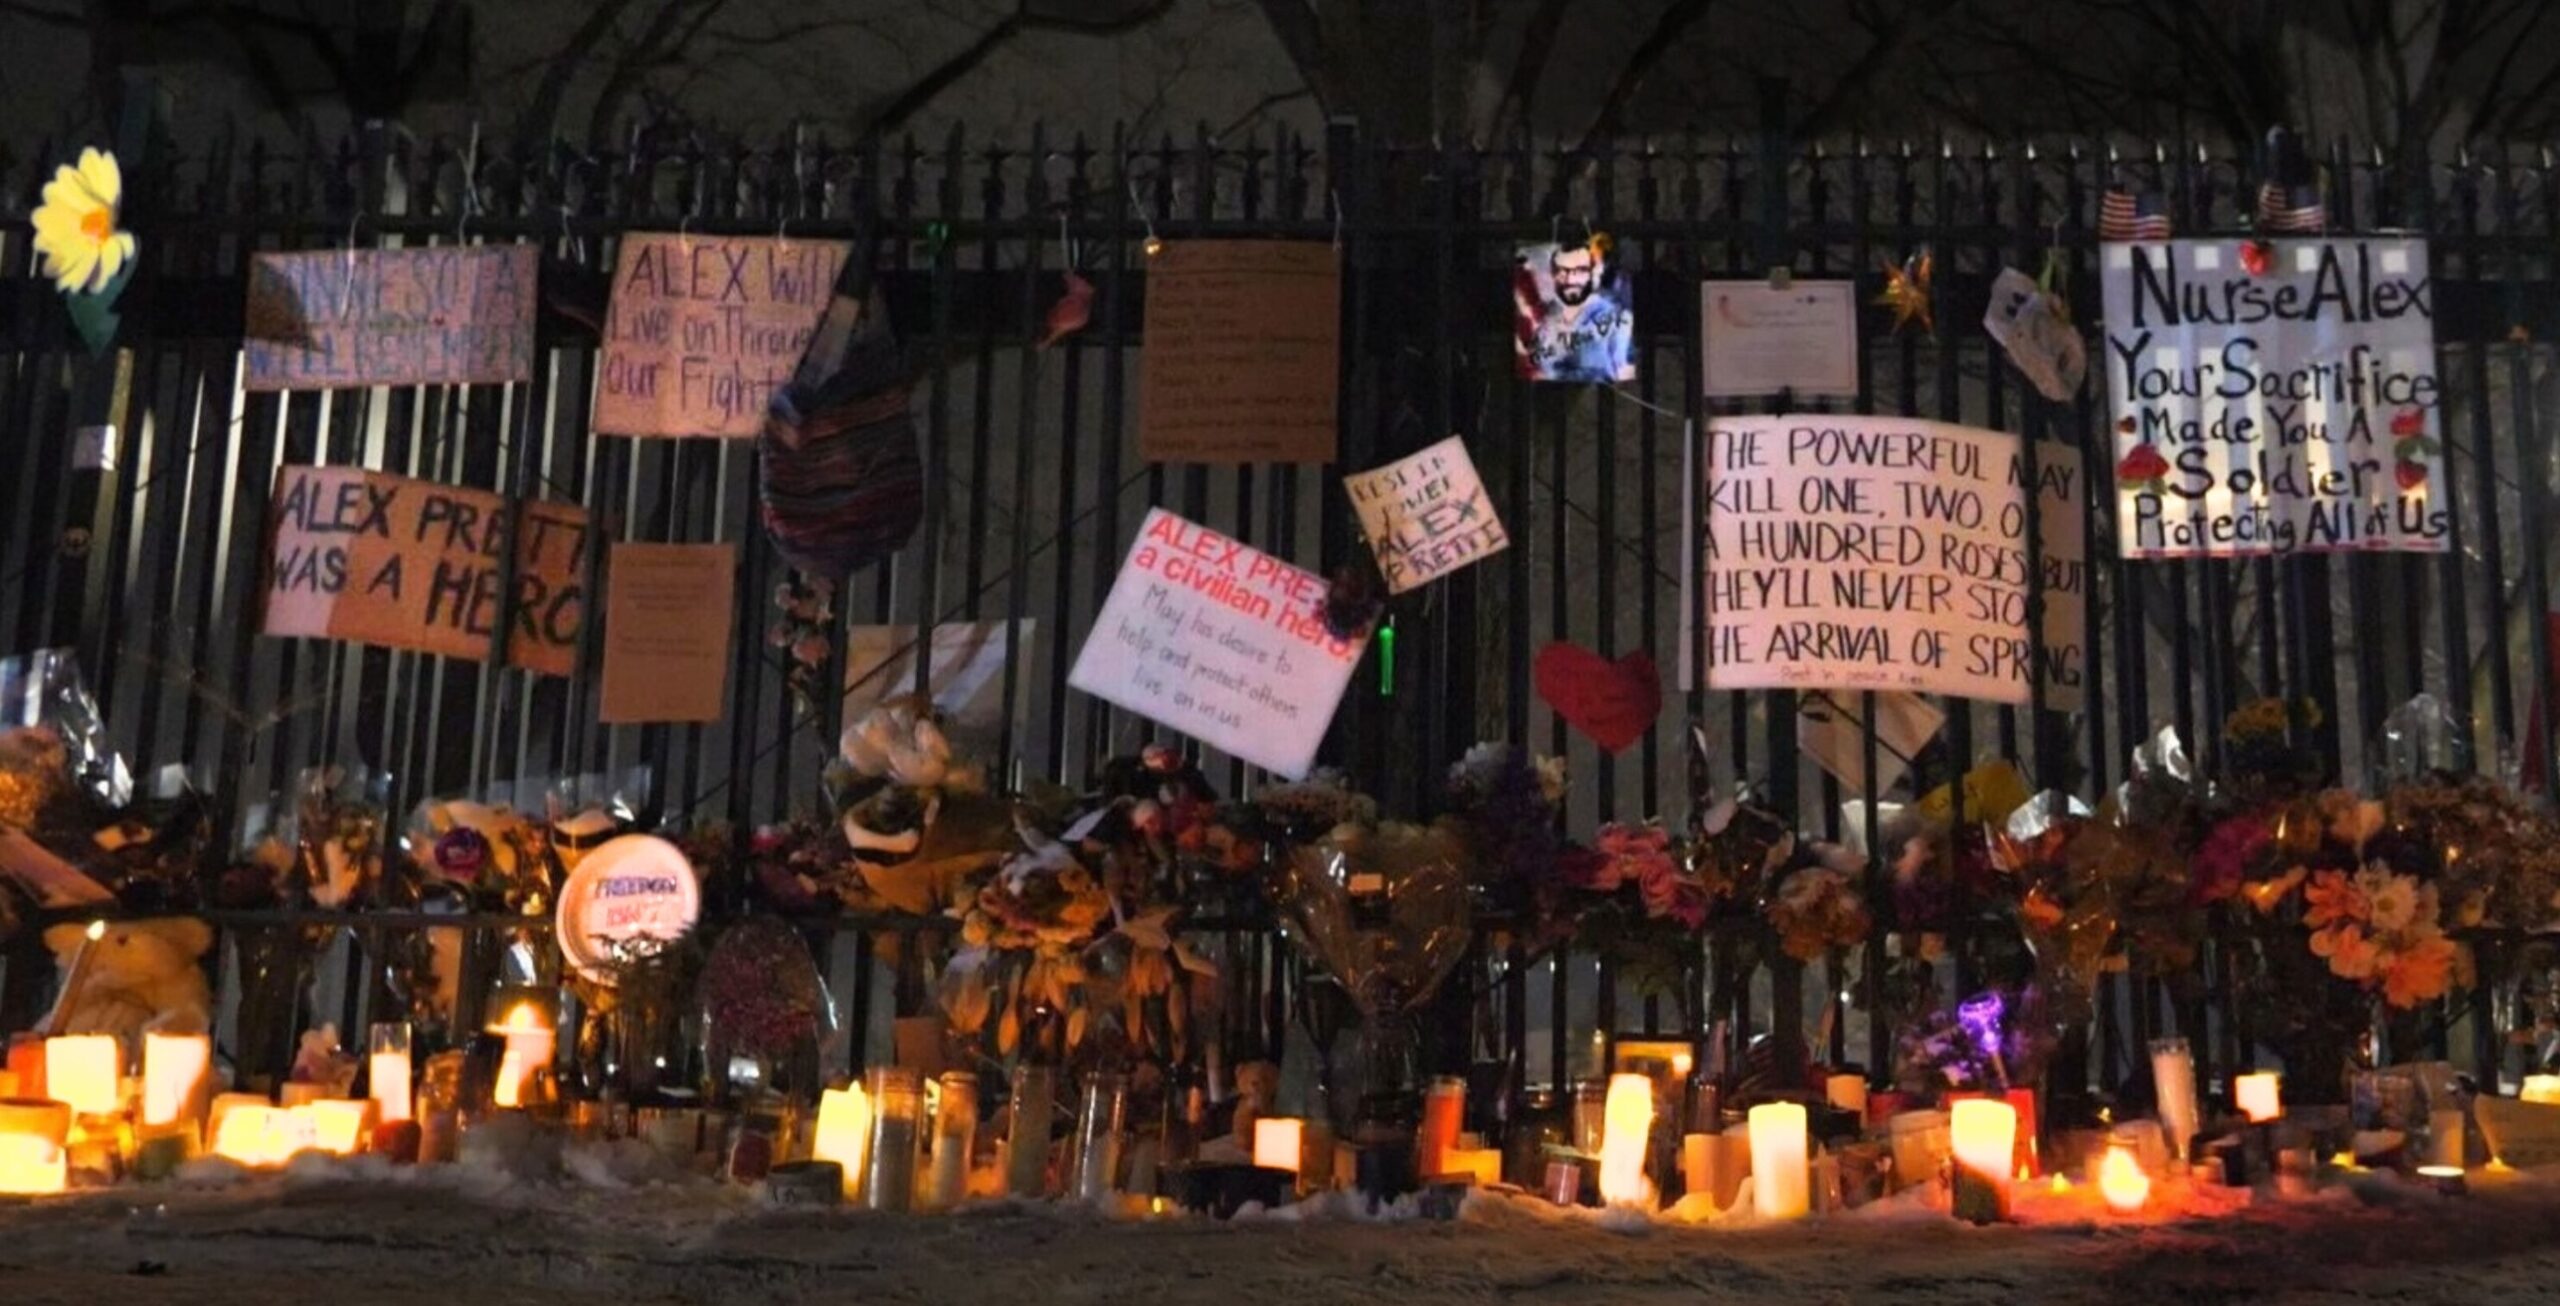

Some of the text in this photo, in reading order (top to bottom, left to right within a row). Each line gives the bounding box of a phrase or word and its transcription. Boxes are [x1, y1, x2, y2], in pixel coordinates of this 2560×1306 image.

[626, 244, 749, 302] ALEX
[2130, 243, 2433, 328] Nurse Alex
[611, 302, 671, 346] Live
[682, 318, 717, 351] on
[680, 357, 780, 427] Fight
[2109, 331, 2442, 407] Your Sacrifice
[1703, 429, 1769, 470] THE
[1789, 427, 1988, 481] POWERFUL
[2141, 404, 2374, 448] Made You A
[1704, 477, 1784, 517] KILL
[2168, 446, 2381, 500] Soldier
[284, 473, 586, 574] ALEX PRETT
[1376, 485, 1480, 557] ALEX
[1740, 520, 1926, 566] HUNDRED
[2134, 493, 2450, 551] Protecting All of Us
[1135, 546, 1158, 570] a
[1163, 556, 1271, 619] civilian
[1148, 514, 1320, 604] ALEX PRE
[271, 546, 583, 645] WAS A HERO
[1143, 582, 1292, 676] May his desire to
[1832, 568, 1952, 615] NEVER
[1967, 583, 2033, 627] STO
[1116, 616, 1299, 720] help and protect others
[1765, 621, 1901, 666] ARRIVAL
[1911, 628, 1951, 669] OF
[1966, 633, 2082, 688] SPRNG
[1131, 663, 1241, 729] live on in us
